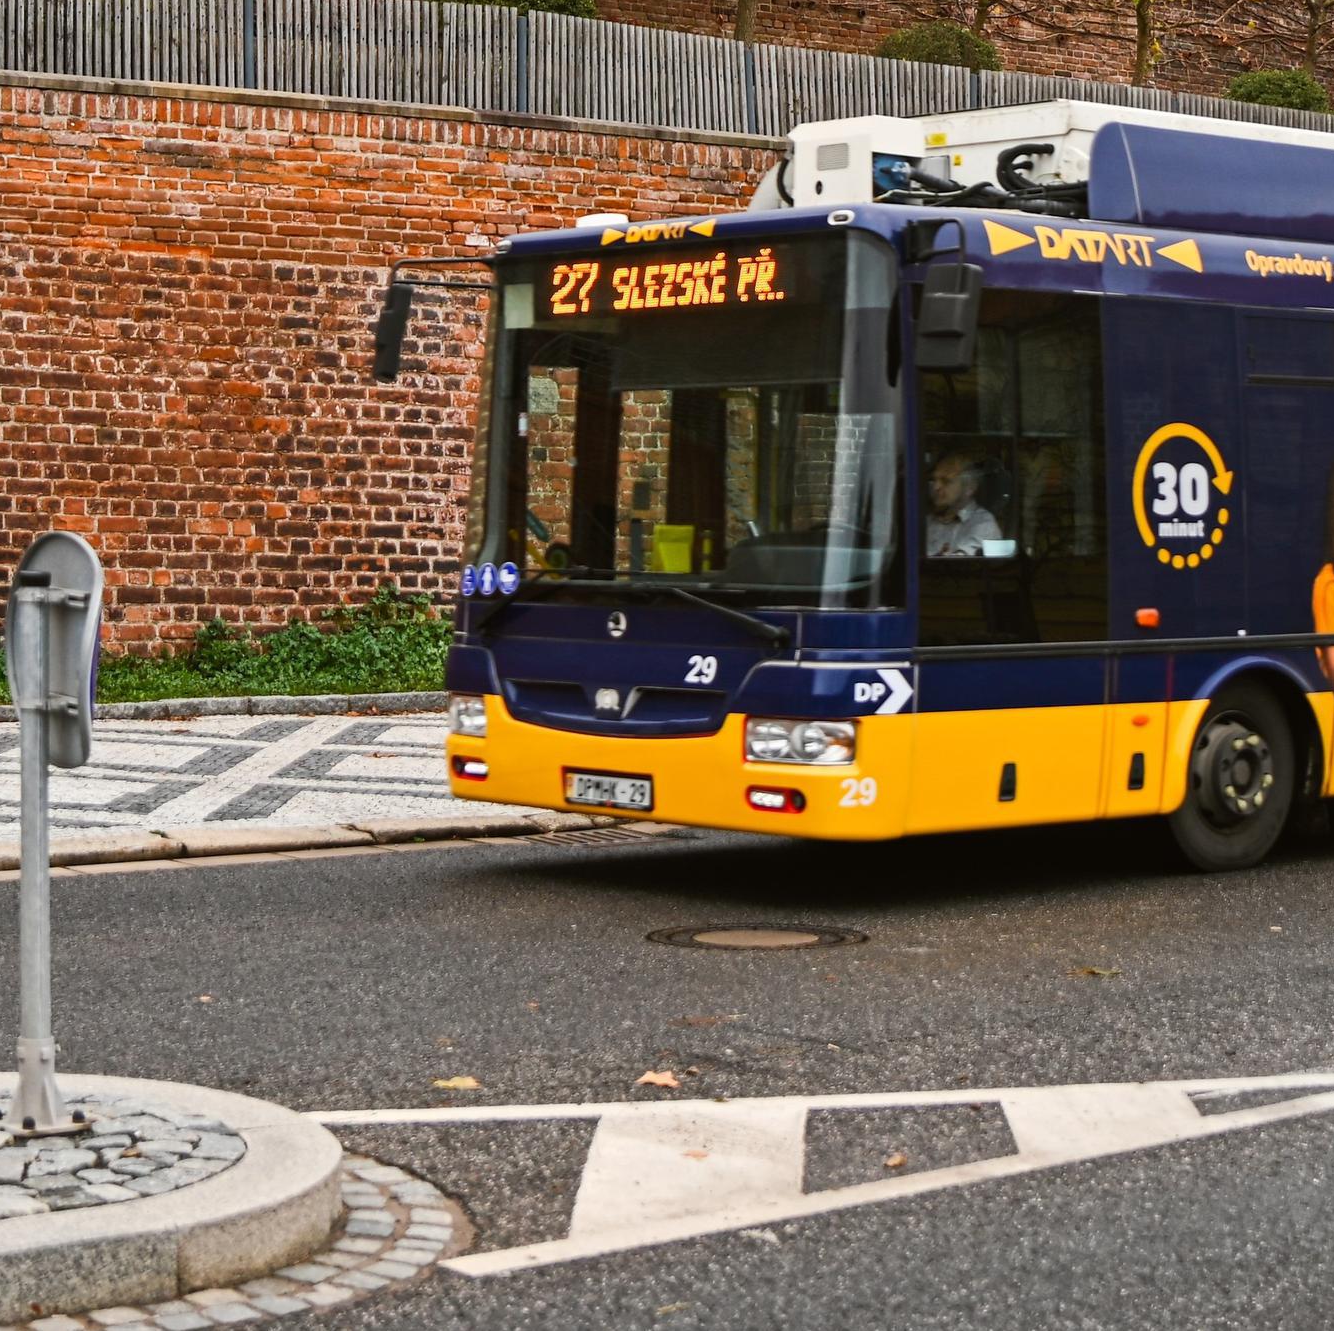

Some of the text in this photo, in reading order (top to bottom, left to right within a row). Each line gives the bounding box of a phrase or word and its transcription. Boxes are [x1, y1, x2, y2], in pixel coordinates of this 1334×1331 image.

[1033, 224, 1156, 268] DATART
[1244, 249, 1333, 283] Opravdový
[551, 262, 599, 314] 27
[612, 252, 726, 310] SLEZSKÉ
[1152, 462, 1209, 516] 30
[1158, 518, 1205, 537] minut
[684, 655, 717, 684] 29
[854, 682, 886, 702] DP
[838, 777, 877, 807] 29
